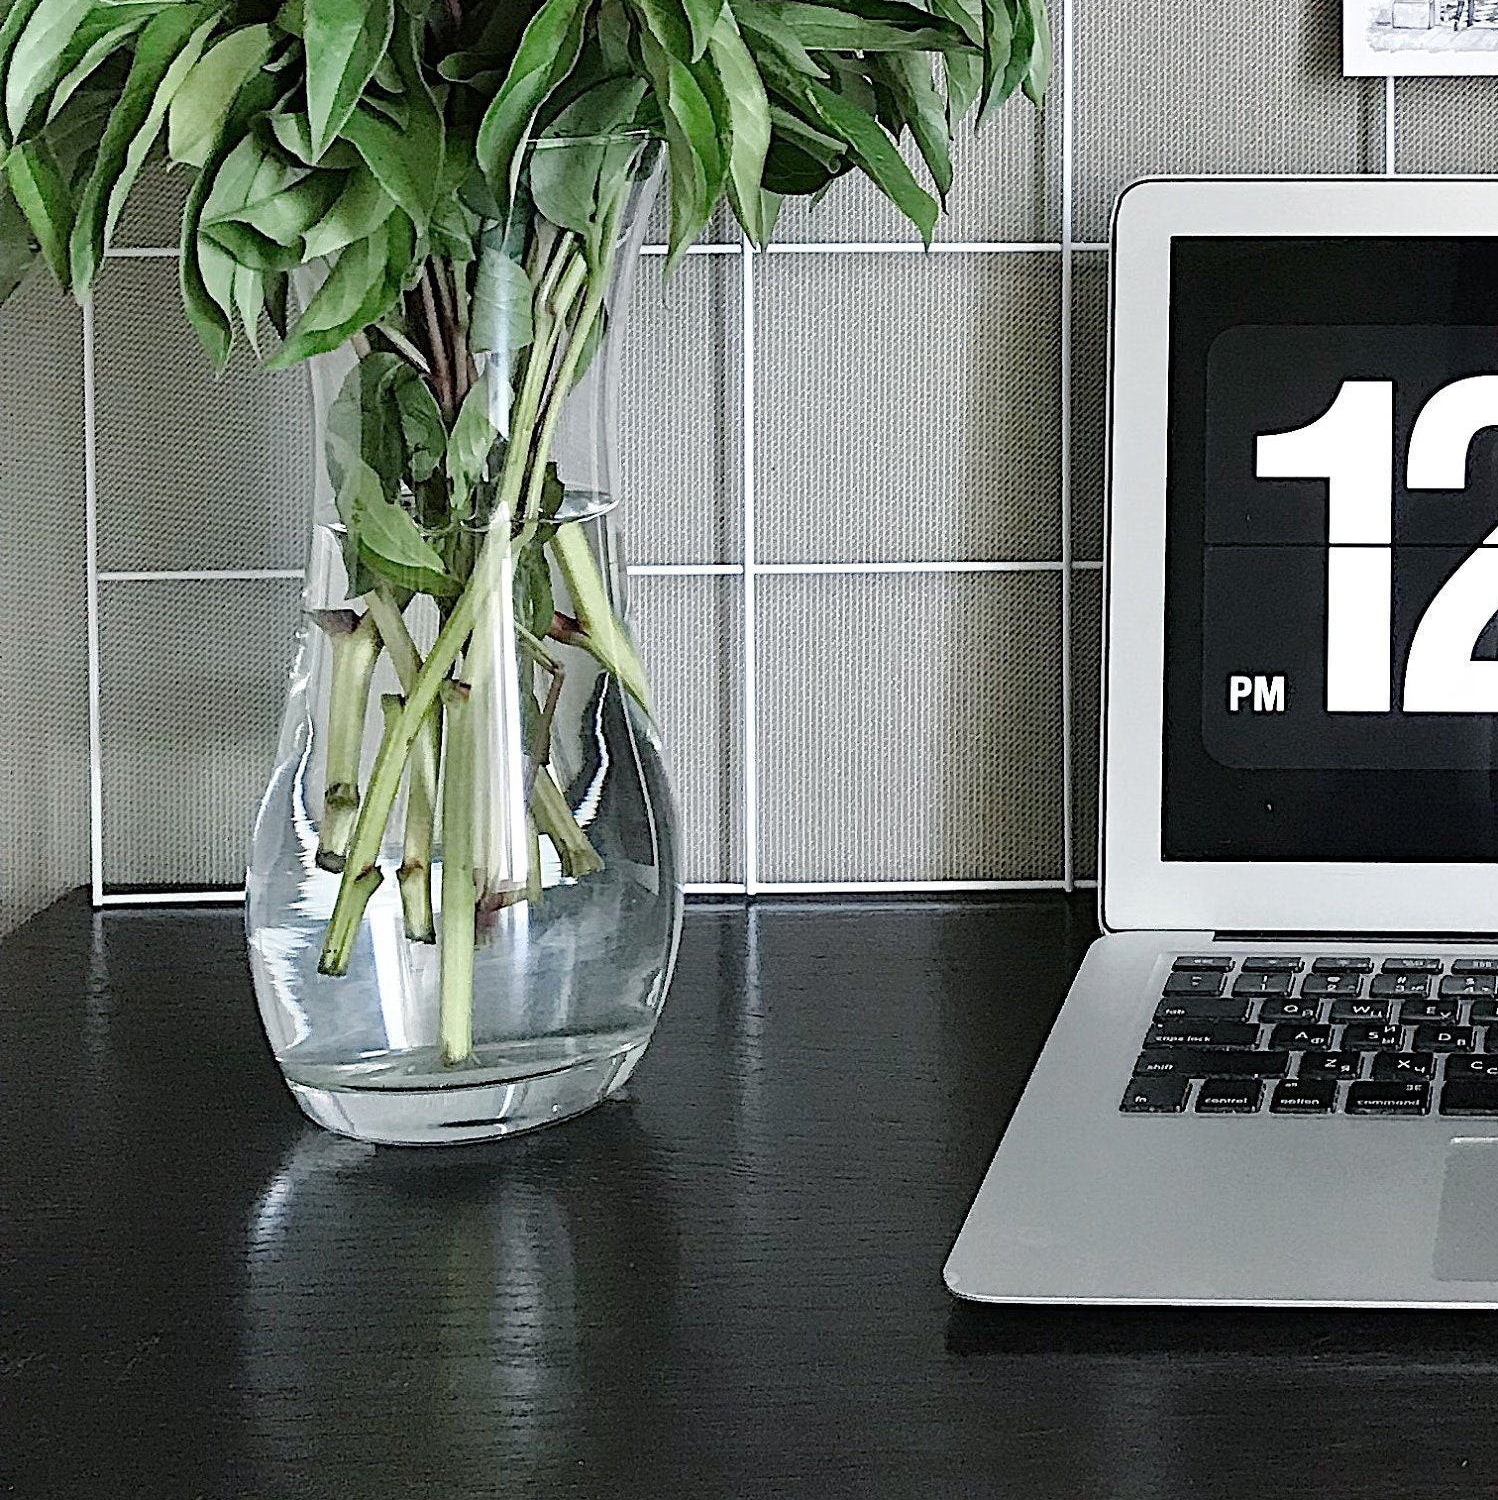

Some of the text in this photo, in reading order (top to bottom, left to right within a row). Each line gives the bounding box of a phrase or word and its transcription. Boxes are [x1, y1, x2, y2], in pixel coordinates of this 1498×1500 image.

[1229, 676, 1286, 712] PM
[1353, 1005, 1370, 1013] W
[1295, 1031, 1308, 1040] A
[1368, 1031, 1379, 1039] S
[1438, 1033, 1451, 1041] D
[1325, 1059, 1337, 1067] Z
[1397, 1060, 1411, 1068] X
[1470, 1061, 1483, 1069] C
